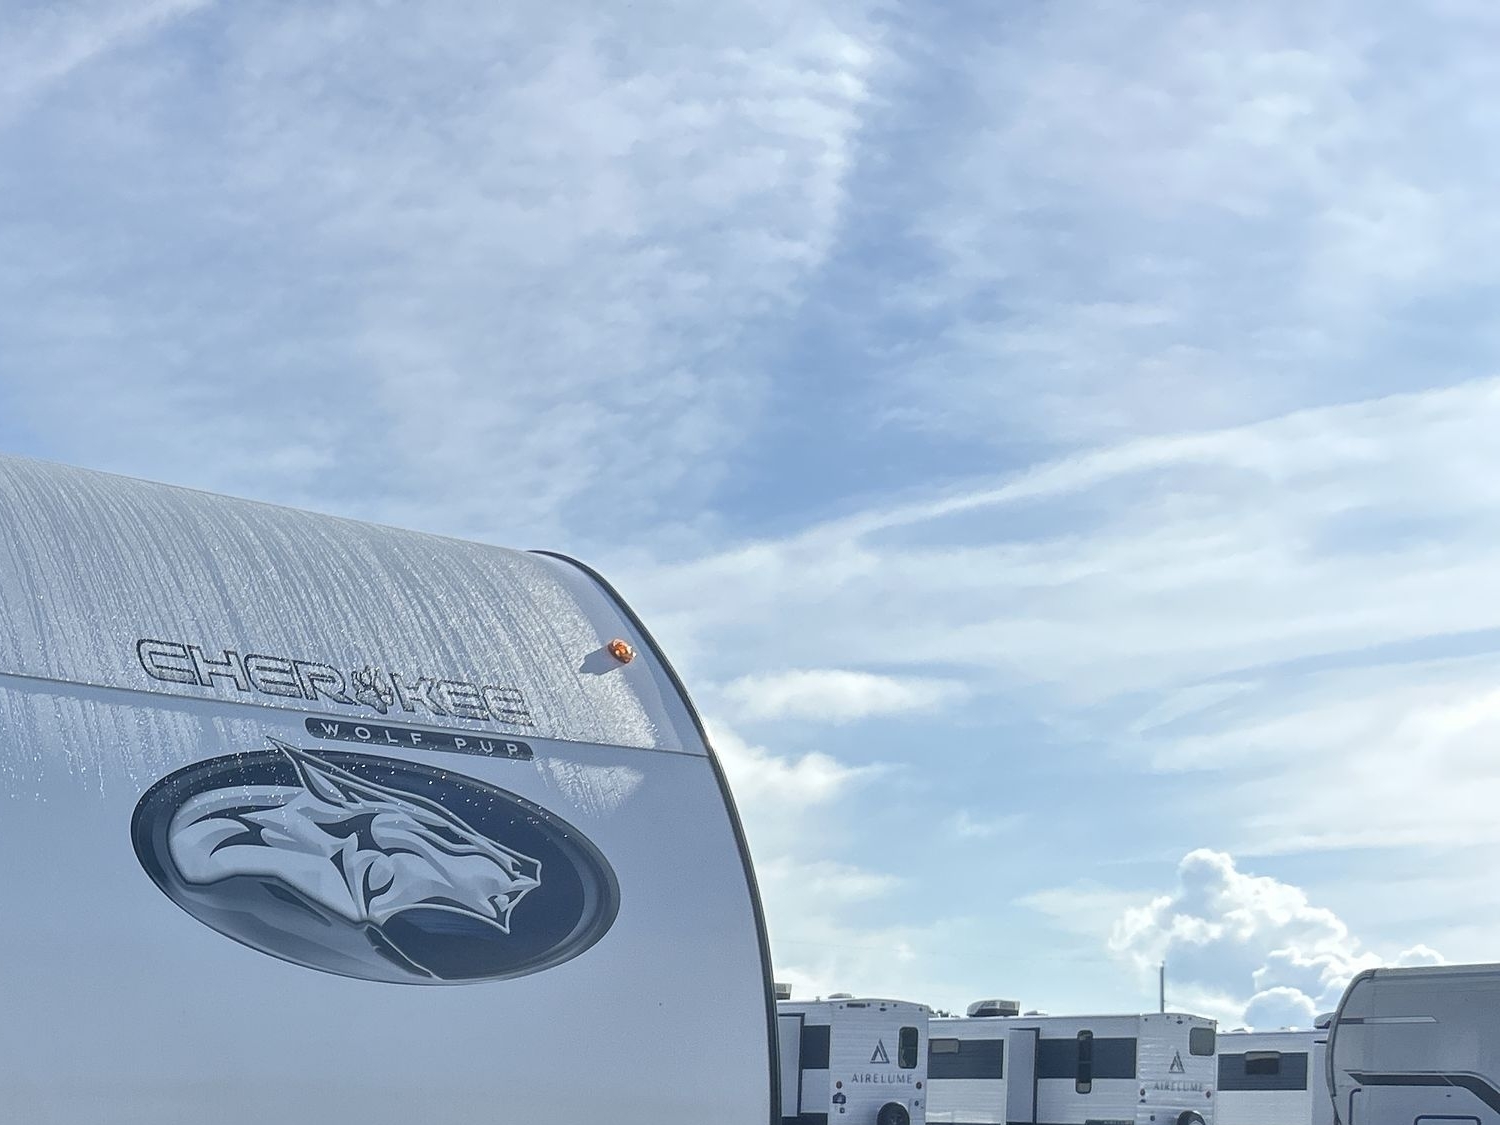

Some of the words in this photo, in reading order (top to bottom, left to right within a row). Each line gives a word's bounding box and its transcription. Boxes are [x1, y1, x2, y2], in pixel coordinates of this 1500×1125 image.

[320, 721, 422, 746] WOLF
[453, 737, 518, 757] PUP
[851, 1073, 914, 1084] AIRELUME
